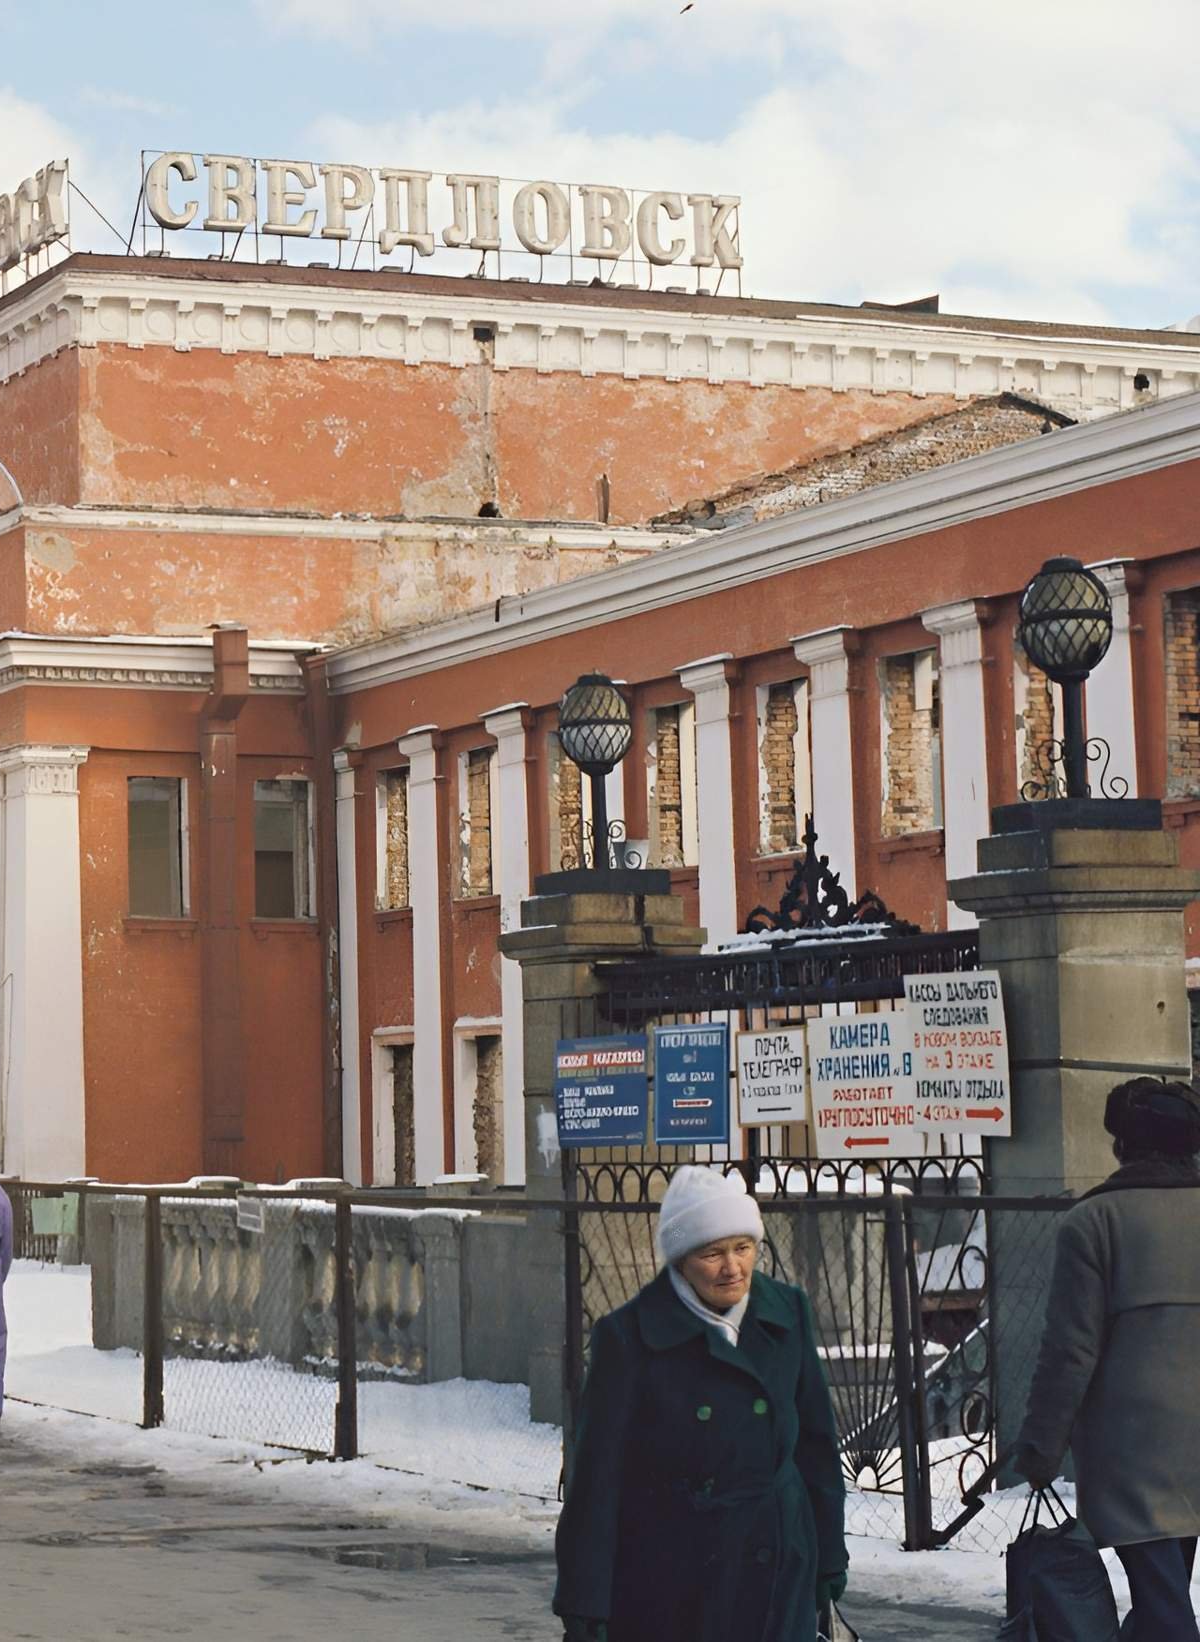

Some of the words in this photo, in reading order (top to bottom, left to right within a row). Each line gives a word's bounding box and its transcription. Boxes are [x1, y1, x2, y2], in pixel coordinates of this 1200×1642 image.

[146, 152, 743, 268] СВЕРДЛОВСК
[830, 1022, 890, 1049] КАМЕРА
[743, 1057, 802, 1080] ТЕЛЕГРАФ
[816, 1053, 890, 1081] ХРАНЕНИЯ
[945, 1050, 953, 1069] 3
[923, 1105, 931, 1120] 4
